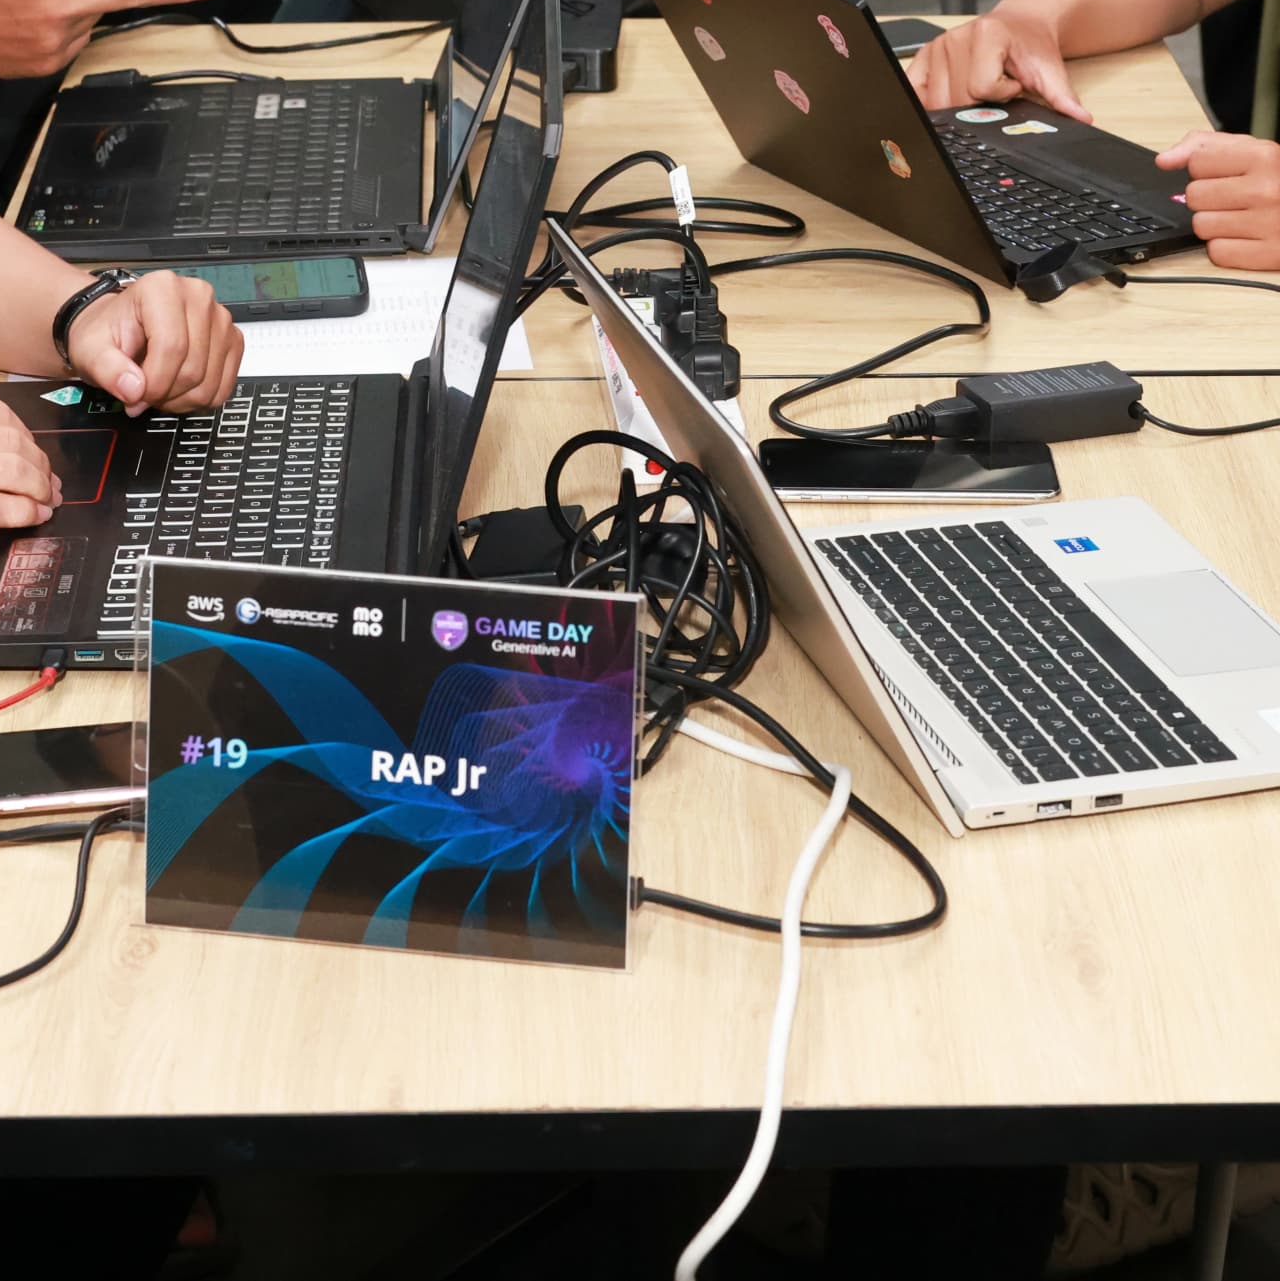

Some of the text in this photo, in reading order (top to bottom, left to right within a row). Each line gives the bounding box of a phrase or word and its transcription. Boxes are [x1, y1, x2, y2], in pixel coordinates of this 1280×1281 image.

[187, 595, 224, 612] aws
[475, 617, 542, 639] GAME
[548, 622, 593, 644] DAY
[492, 639, 576, 658] Generative AI
[180, 736, 248, 769] #19
[372, 751, 486, 796] RAP Jr
